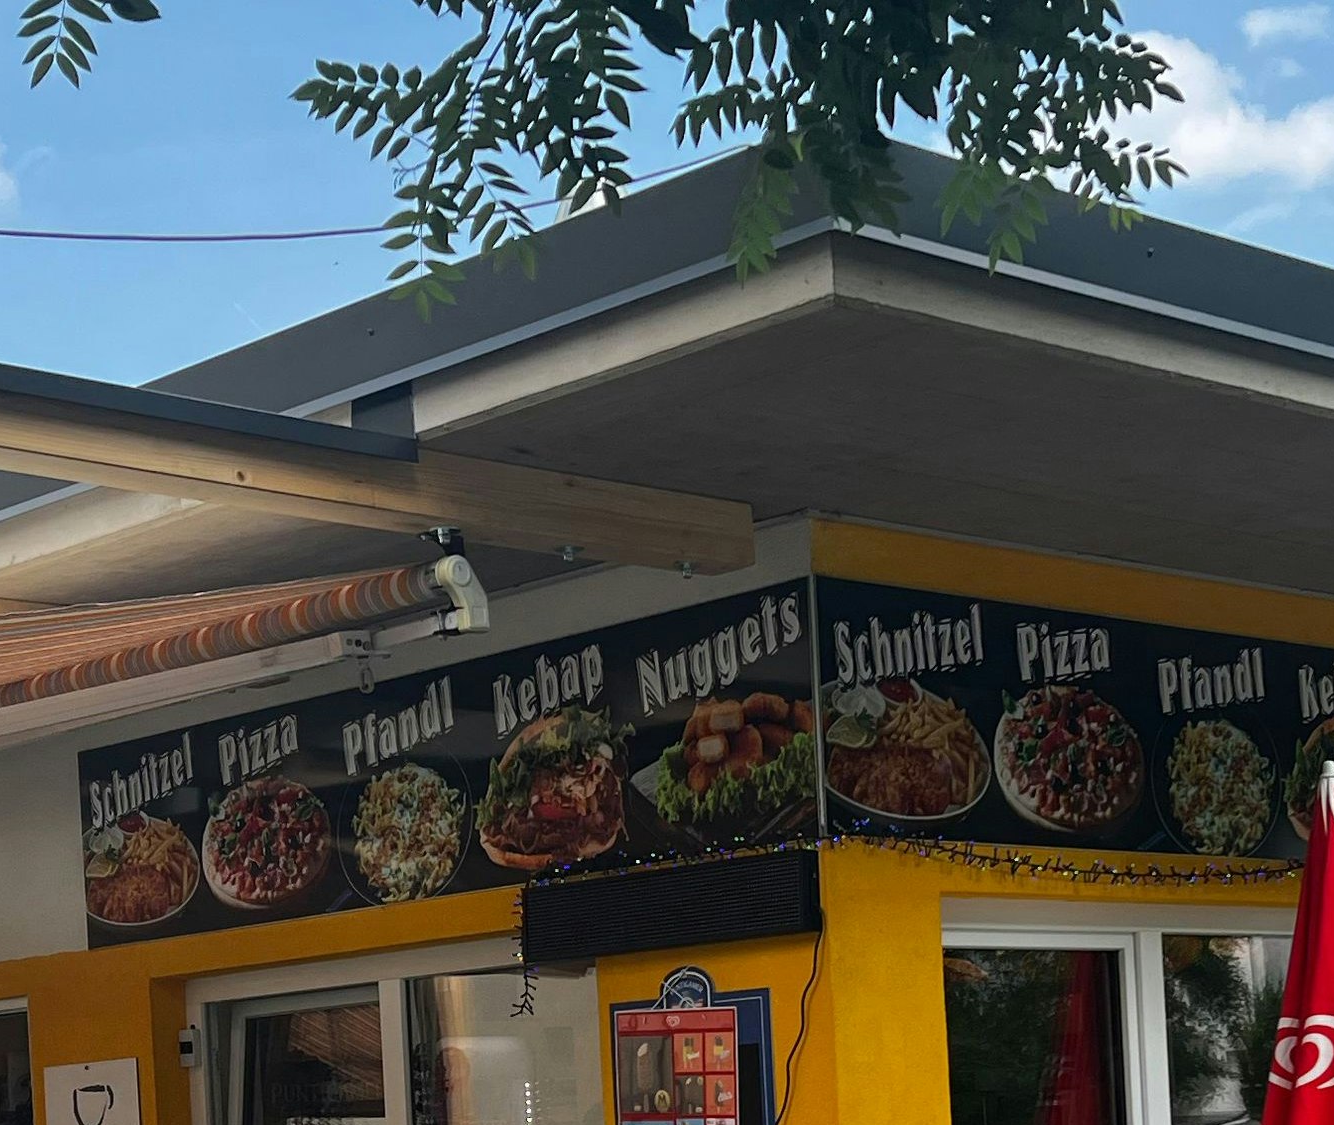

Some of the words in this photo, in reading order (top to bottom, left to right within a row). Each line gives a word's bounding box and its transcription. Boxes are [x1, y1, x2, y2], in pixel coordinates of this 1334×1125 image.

[90, 731, 196, 830] Schnitzel
[218, 712, 300, 787] Pizza
[342, 674, 455, 777] Pfandl
[492, 642, 605, 738] Kebap
[634, 589, 804, 717] Nuggets
[833, 602, 986, 686] Schnitzel
[1015, 622, 1112, 684] Pizza
[1157, 646, 1266, 716] Pfandl
